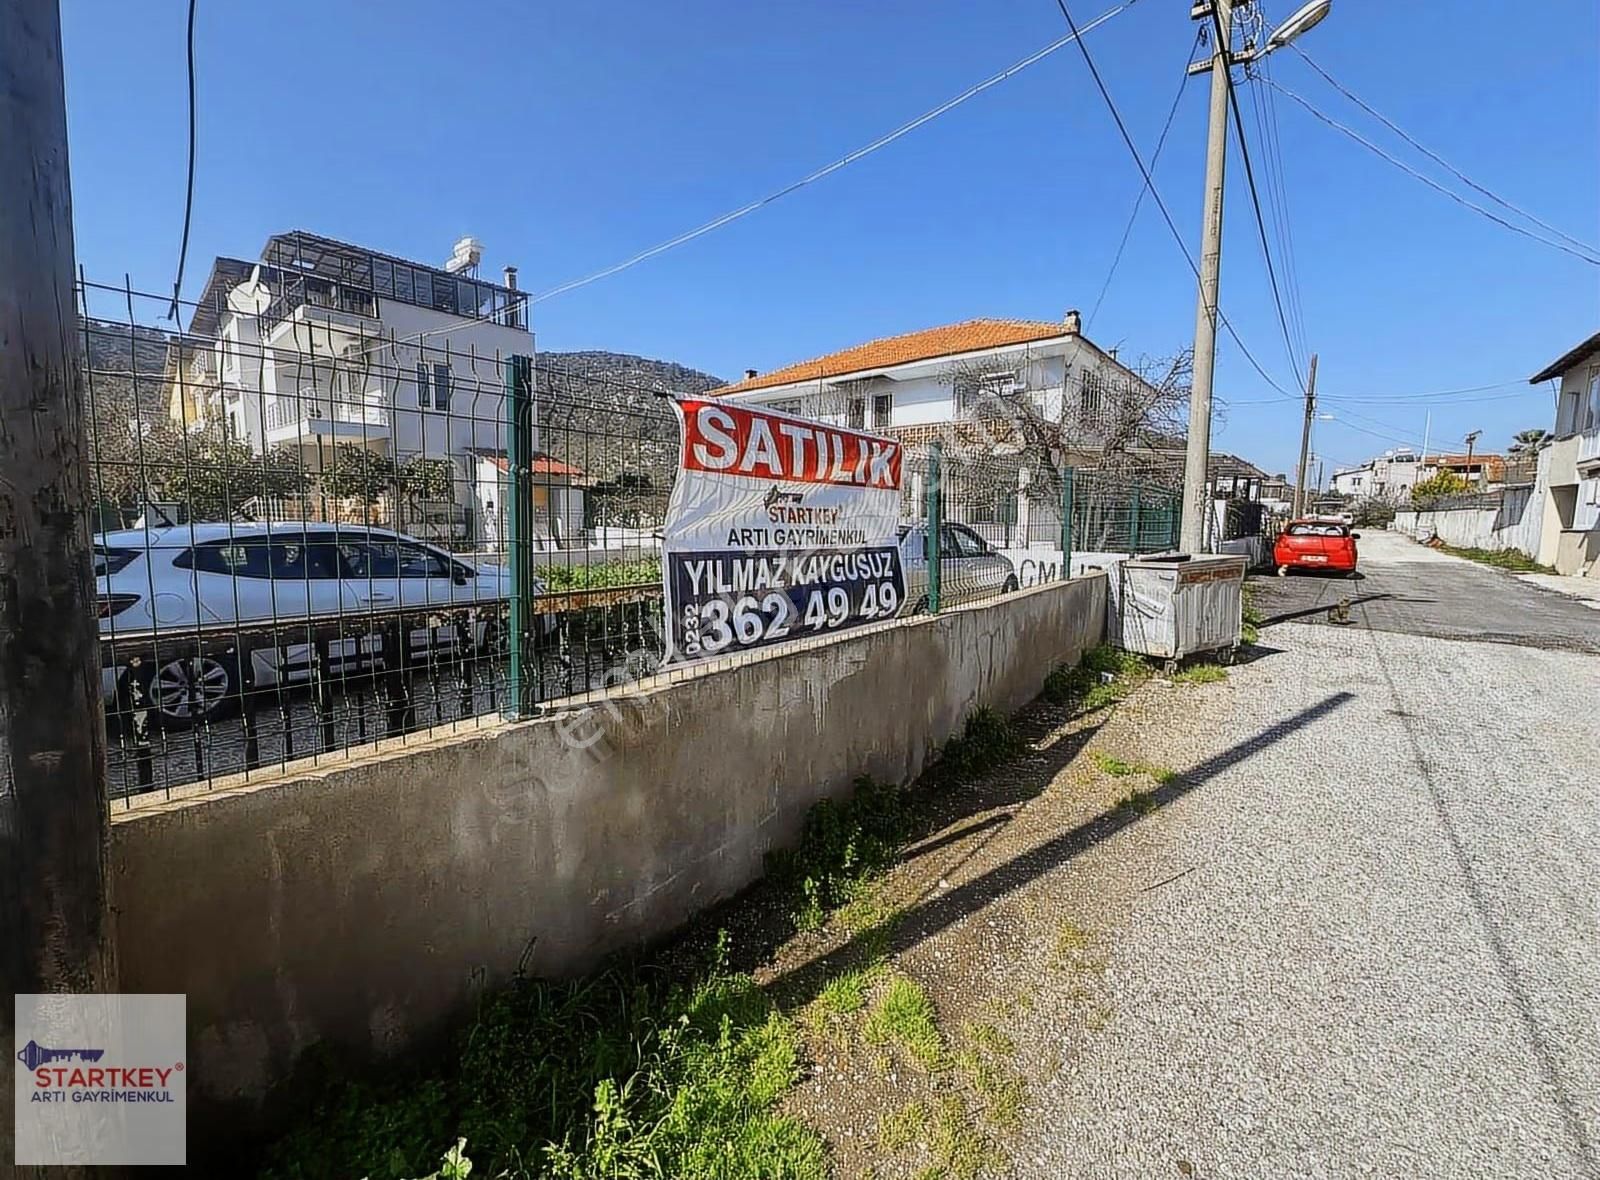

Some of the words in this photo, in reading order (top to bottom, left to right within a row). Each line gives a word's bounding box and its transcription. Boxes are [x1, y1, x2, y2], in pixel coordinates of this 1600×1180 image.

[693, 405, 895, 487] SATILIK
[728, 529, 768, 546] ARTI
[774, 526, 867, 545] GAYRİMENKUL
[684, 557, 786, 595] YILMAZ
[791, 553, 893, 586] KAYGUSUZ
[684, 602, 699, 654] 0232
[700, 592, 789, 651] 362
[804, 587, 849, 630] 49
[860, 582, 896, 618] 49
